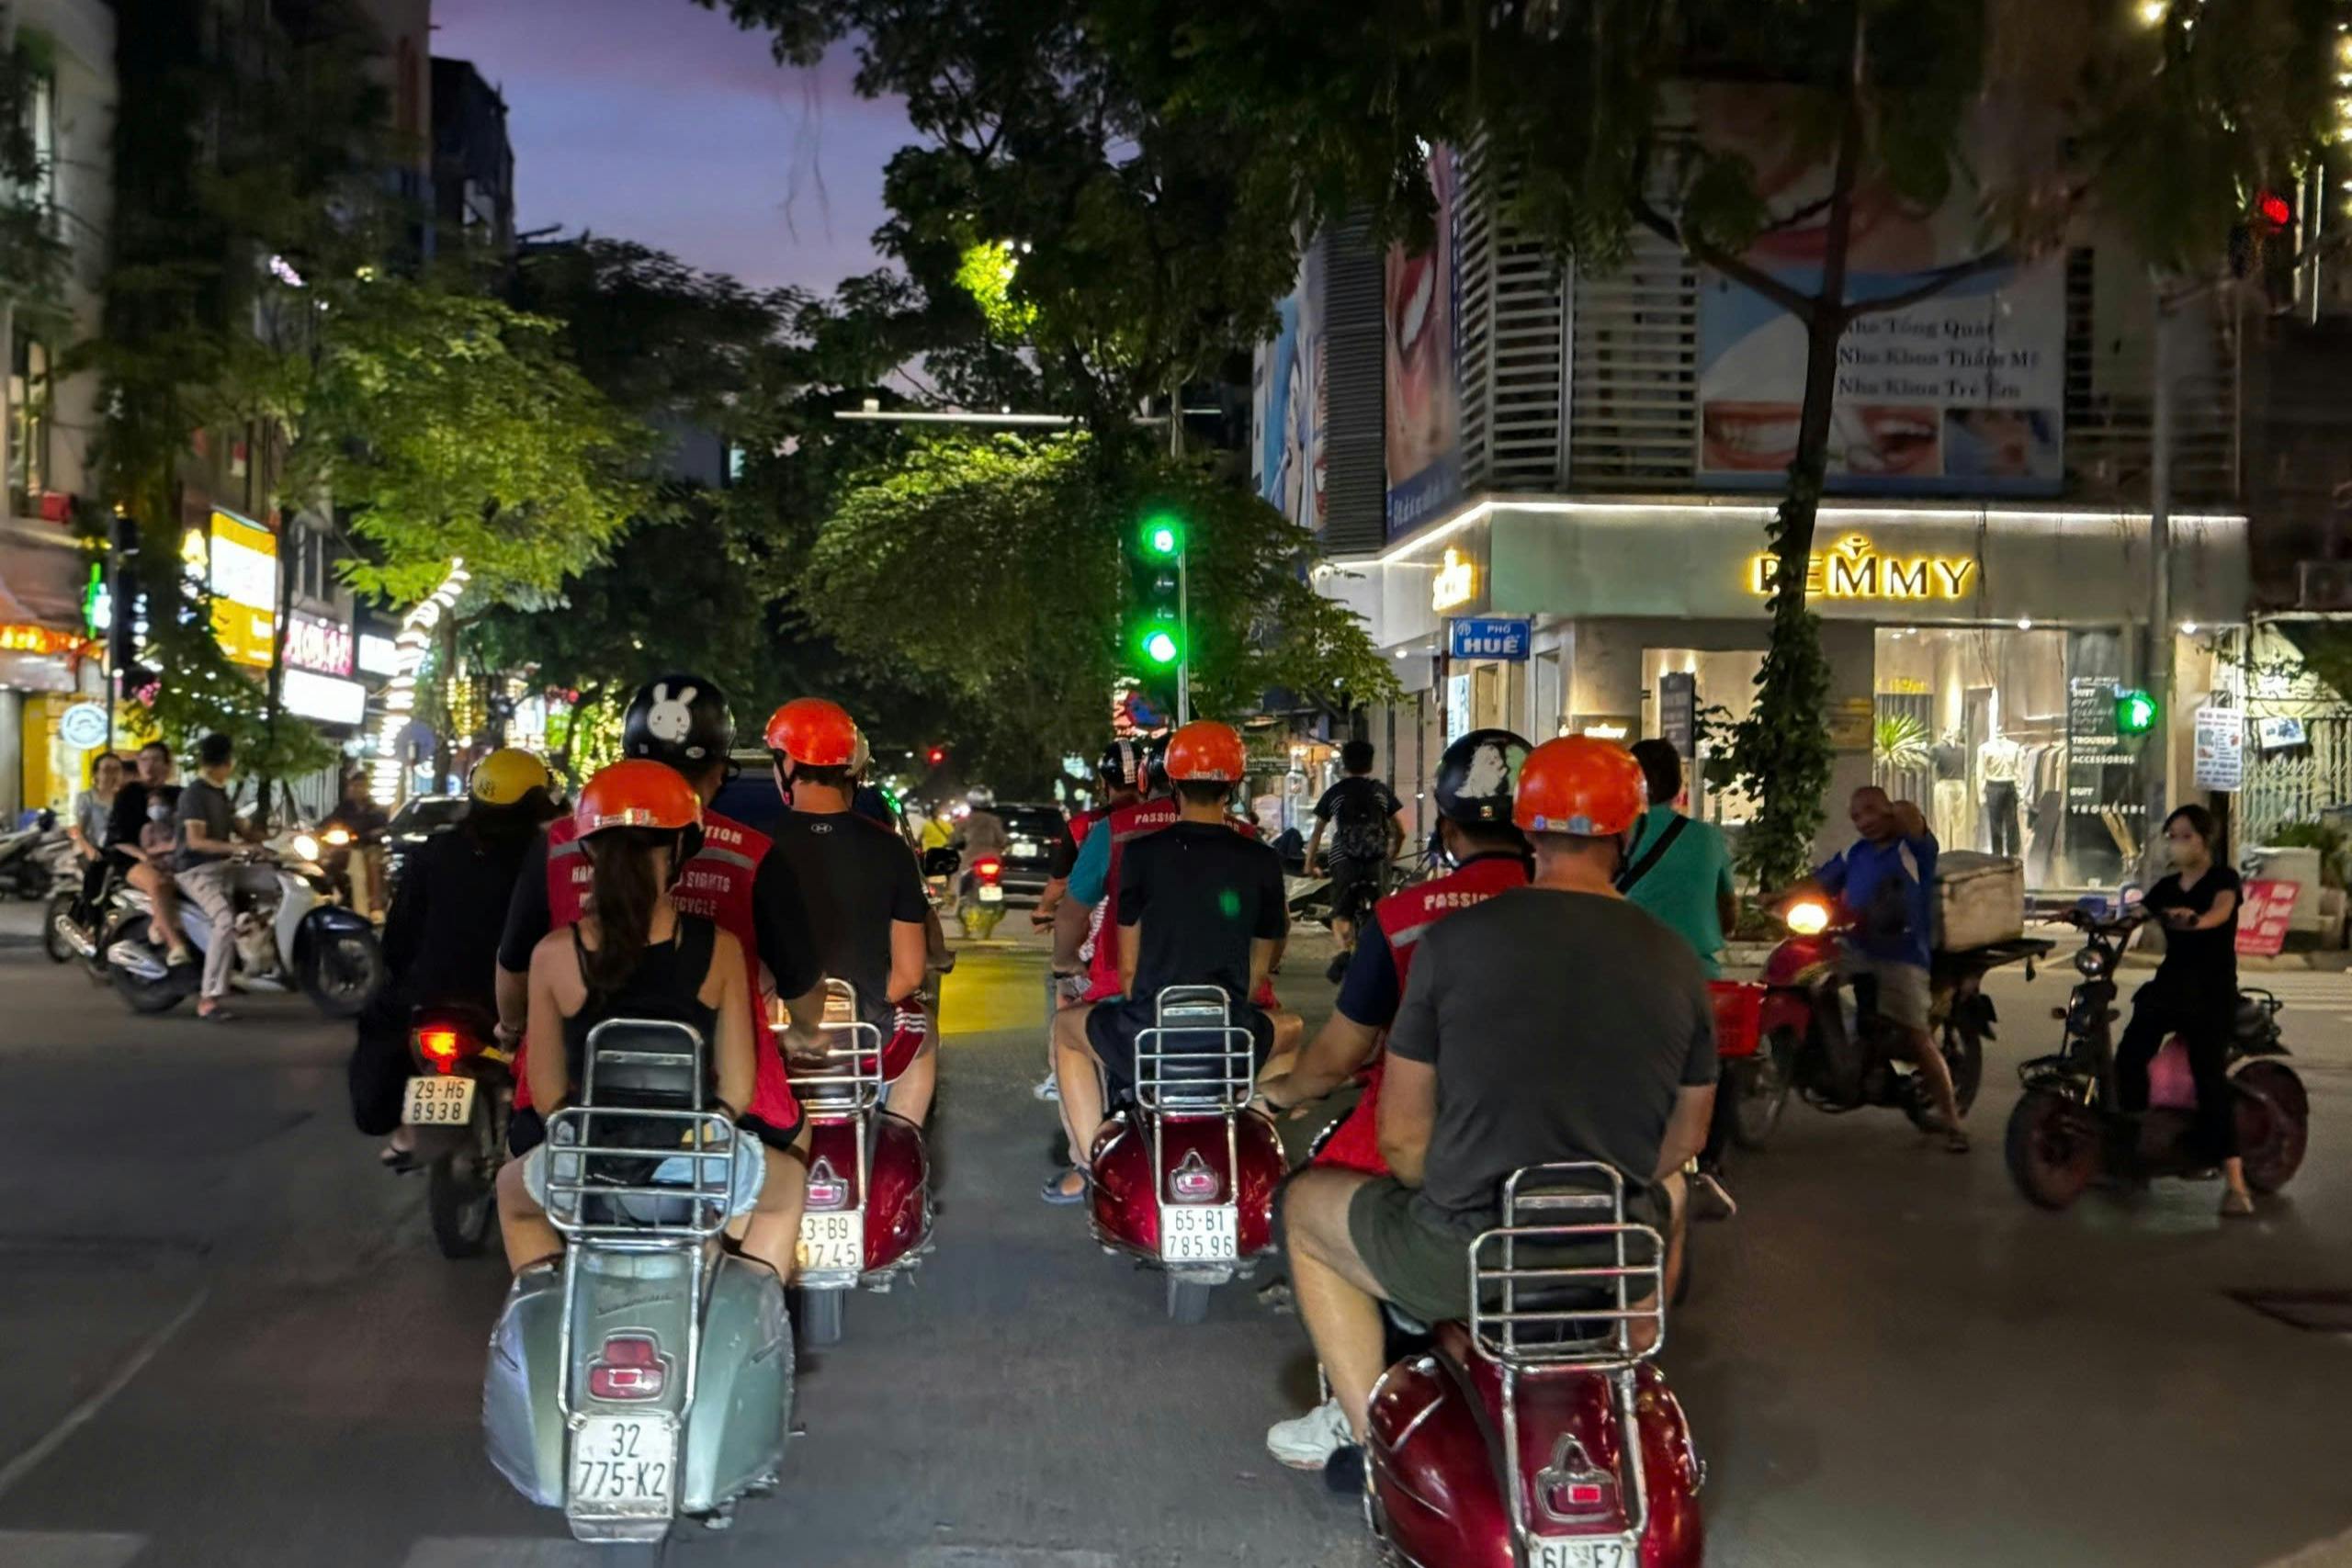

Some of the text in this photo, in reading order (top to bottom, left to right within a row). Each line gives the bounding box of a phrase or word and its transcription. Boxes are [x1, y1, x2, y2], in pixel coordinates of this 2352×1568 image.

[1464, 634, 1521, 653] HUẾ
[1135, 812, 1181, 825] PASSIO
[1424, 892, 1490, 910] PASSIO
[413, 1101, 461, 1121] 8938
[799, 1217, 848, 1240] 3-B9
[611, 1423, 640, 1458] 32
[580, 1461, 666, 1497] 775-K2
